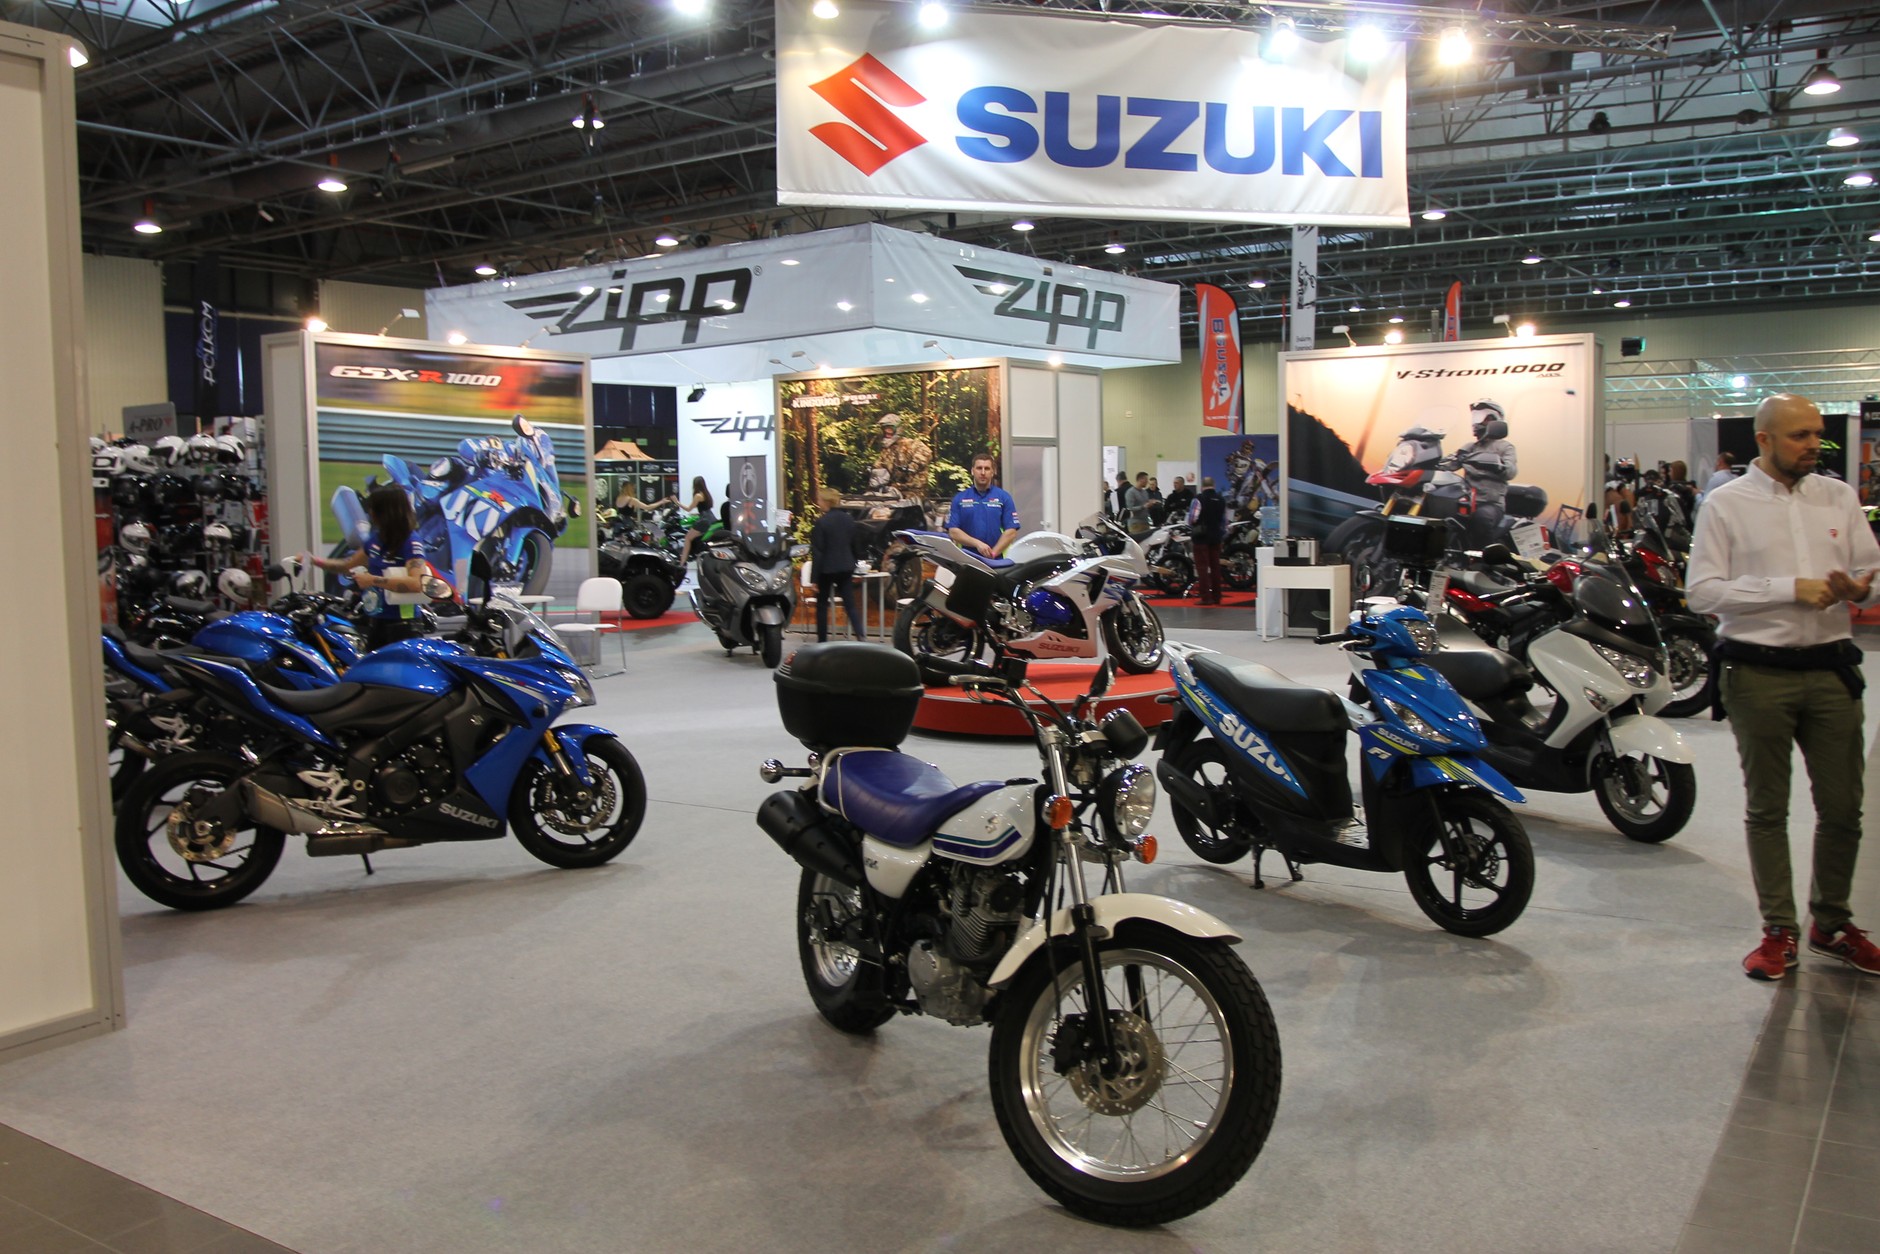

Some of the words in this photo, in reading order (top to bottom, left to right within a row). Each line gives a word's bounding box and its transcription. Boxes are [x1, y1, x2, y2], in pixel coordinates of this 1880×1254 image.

[954, 85, 1383, 179] SUZUKI
[447, 372, 503, 388] 1000
[1502, 362, 1566, 375] 1000
[1376, 727, 1420, 751] SUZUKI
[438, 802, 499, 829] SUZUKI
